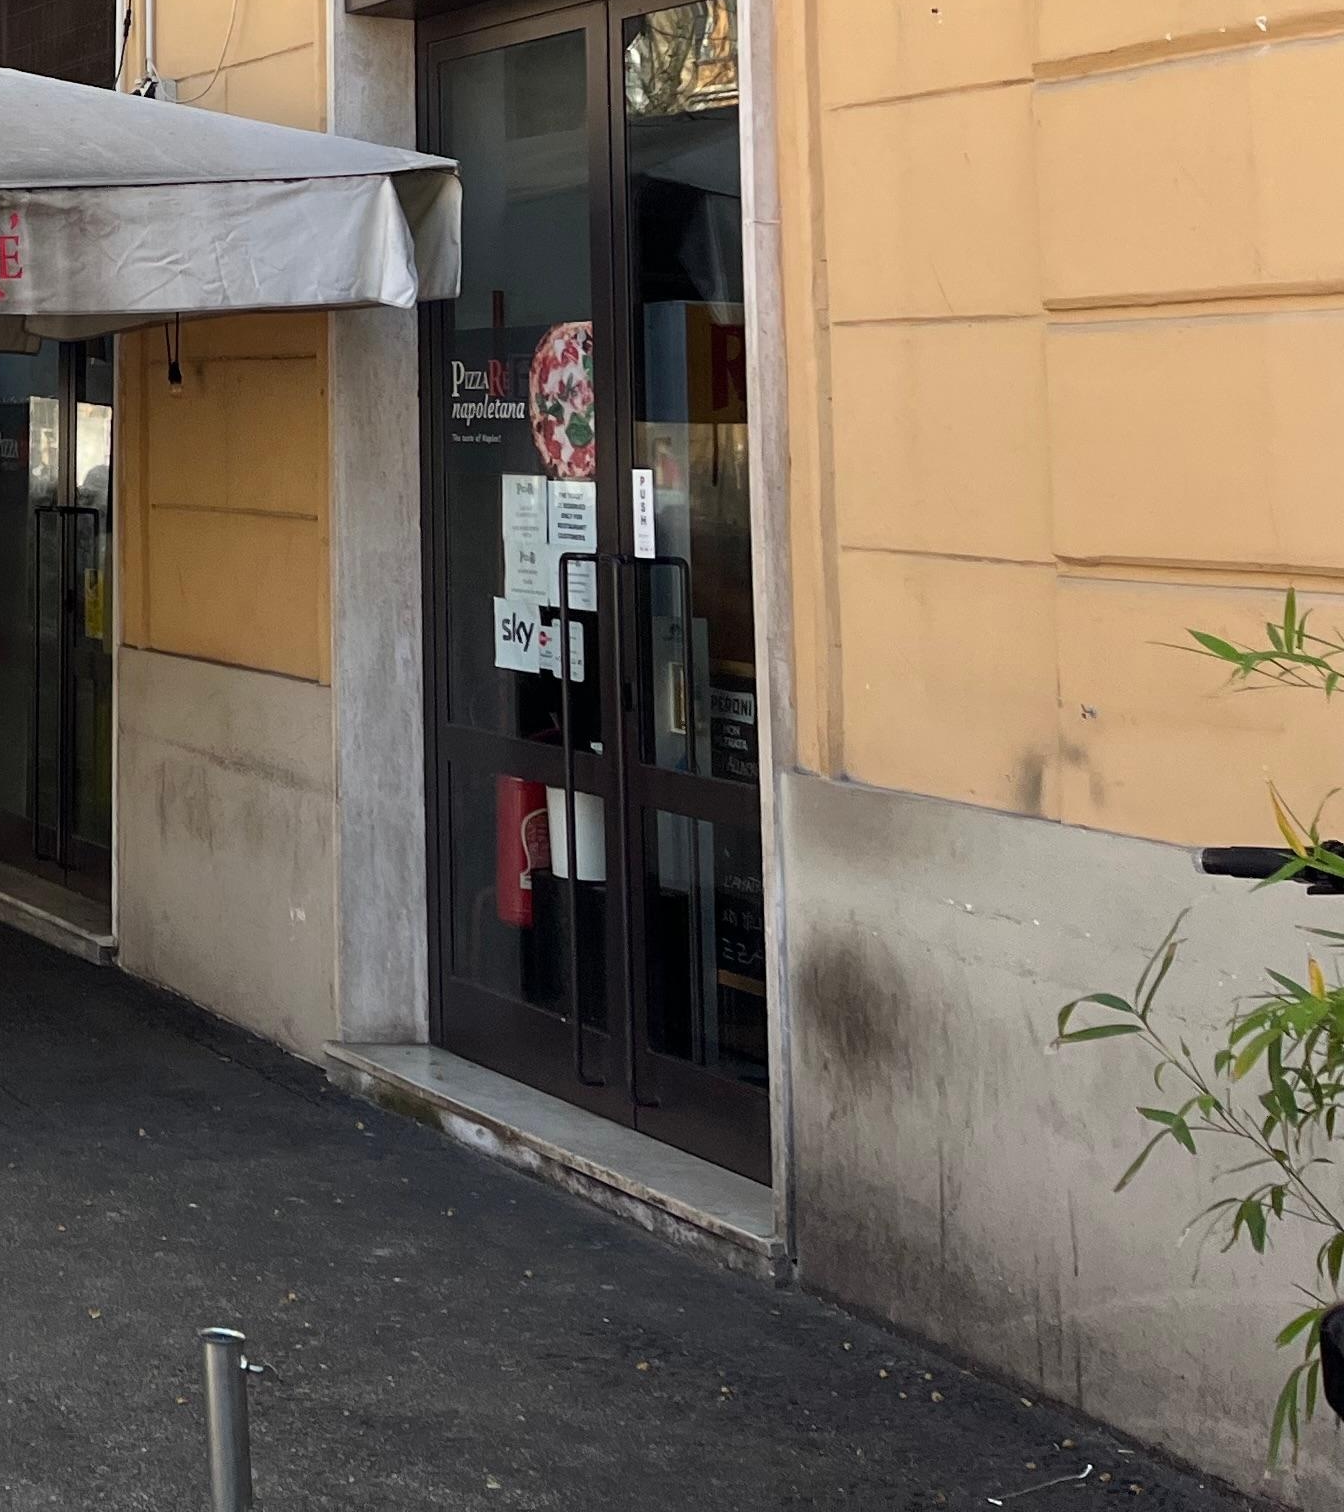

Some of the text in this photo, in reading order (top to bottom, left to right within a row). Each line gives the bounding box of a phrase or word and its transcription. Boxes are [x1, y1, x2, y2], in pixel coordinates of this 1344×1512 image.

[451, 394, 525, 426] napoletana
[640, 475, 648, 526] PUSH
[502, 612, 534, 653] sky
[711, 693, 752, 717] PERONI
